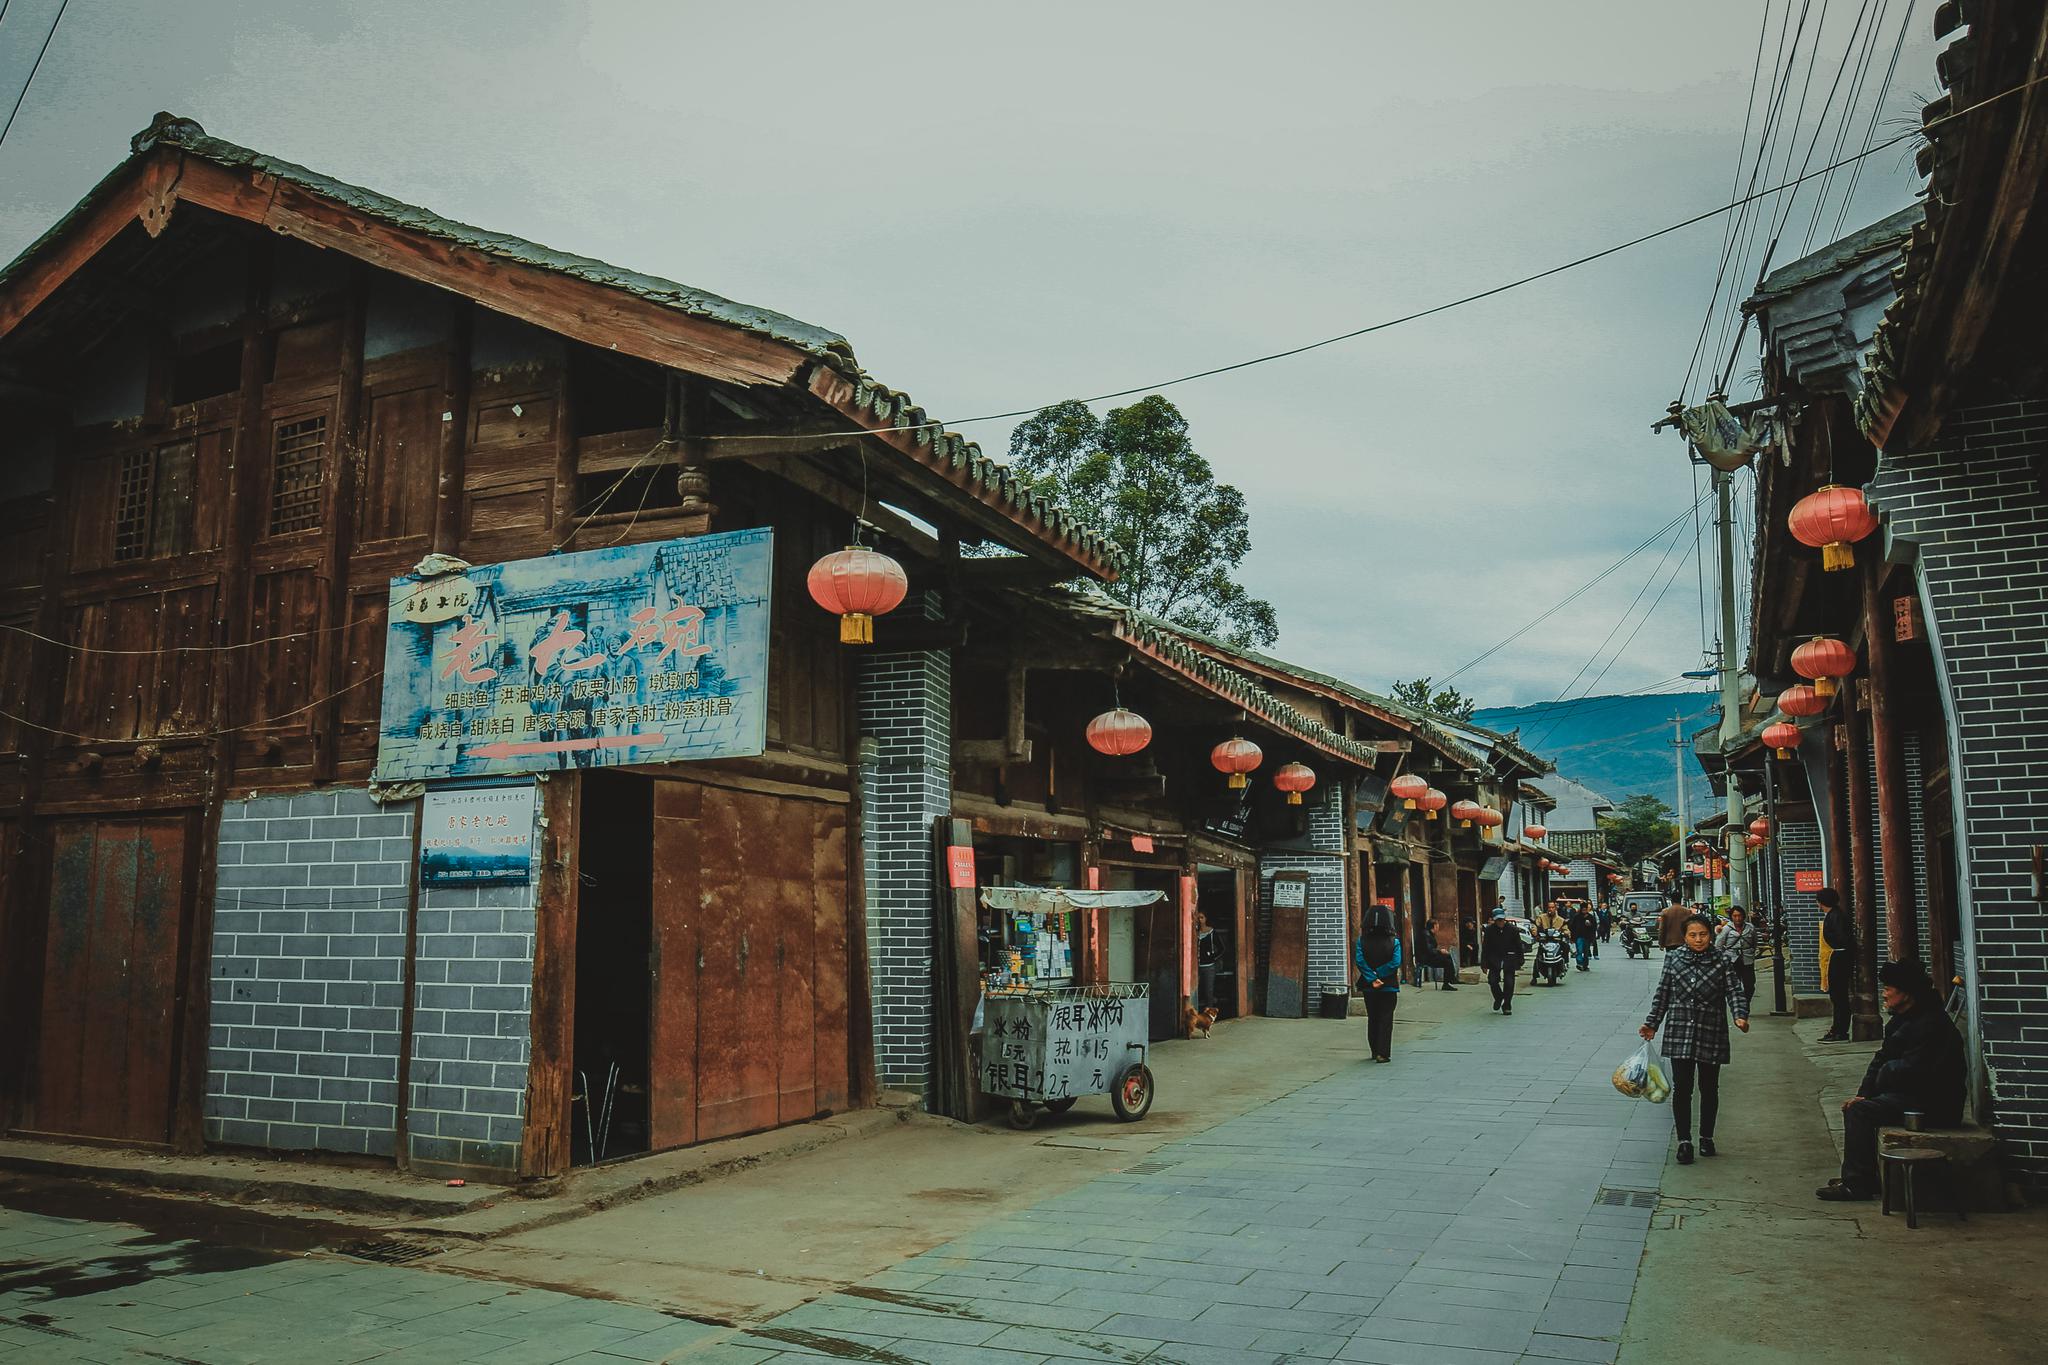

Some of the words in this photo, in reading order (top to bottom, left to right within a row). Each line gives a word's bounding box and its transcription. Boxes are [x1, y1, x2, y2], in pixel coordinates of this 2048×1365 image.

[573, 674, 637, 698] 板栗小肠
[649, 669, 699, 691] 墩墩肉
[419, 720, 462, 740] 咸烧白
[470, 716, 515, 737] 甜烧白
[522, 710, 586, 732] 唐家香碗
[593, 703, 657, 726] 唐家香肘
[665, 698, 732, 720] 粉蒸排骨
[993, 1016, 1032, 1040] 冰粉
[1050, 999, 1124, 1034] 银耳冰粉
[1053, 1037, 1071, 1064] 热
[1094, 1039, 1109, 1060] 1.5
[1090, 1068, 1104, 1090] 元
